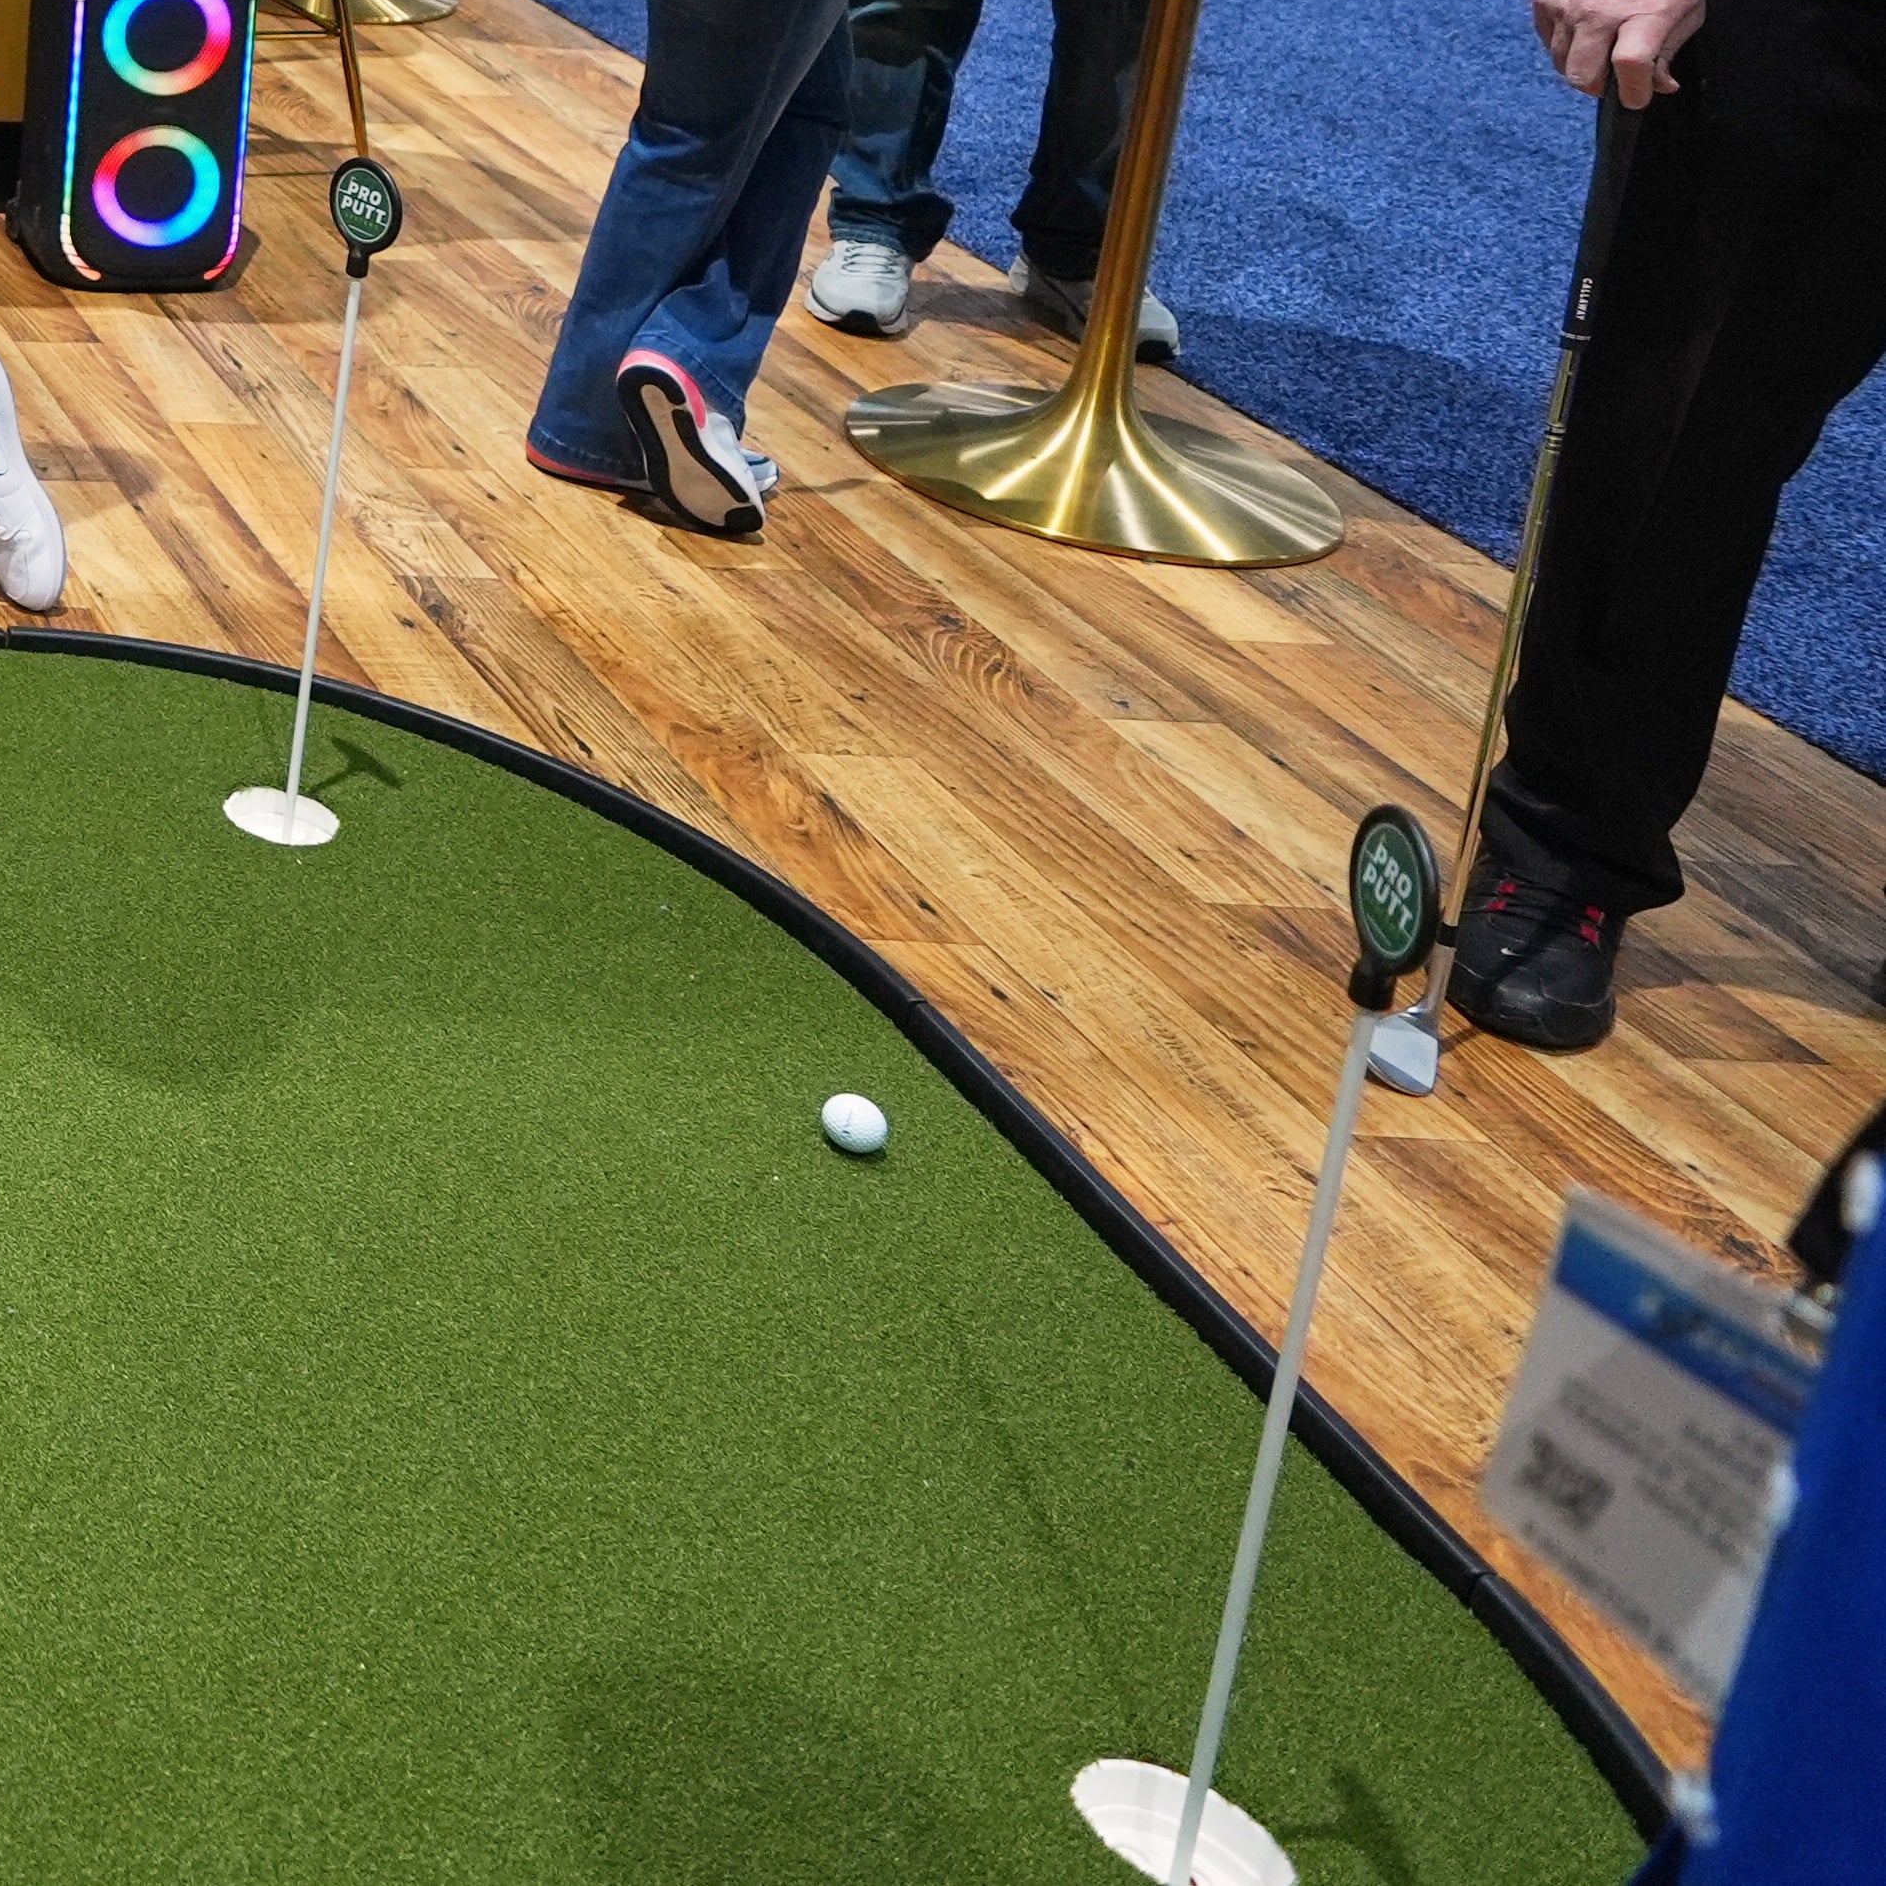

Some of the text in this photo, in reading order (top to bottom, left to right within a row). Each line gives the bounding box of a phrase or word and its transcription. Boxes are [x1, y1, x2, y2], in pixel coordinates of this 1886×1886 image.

[340, 195, 388, 225] PUTT
[347, 180, 383, 207] PRO
[1372, 841, 1413, 900] PRO
[1362, 862, 1414, 930] PUTT
